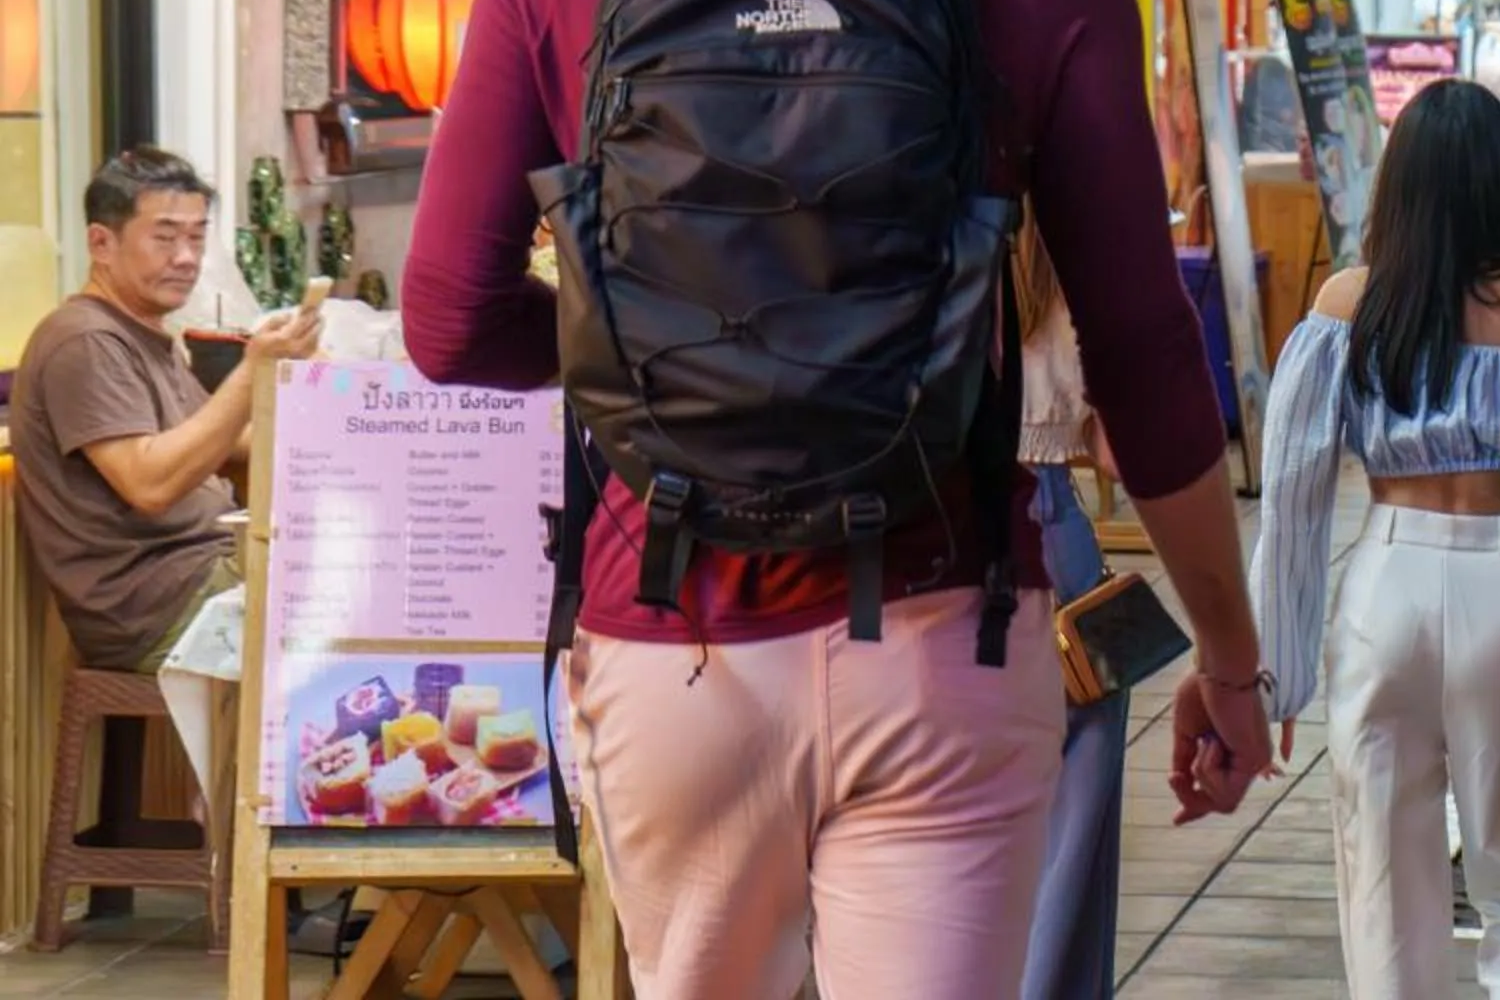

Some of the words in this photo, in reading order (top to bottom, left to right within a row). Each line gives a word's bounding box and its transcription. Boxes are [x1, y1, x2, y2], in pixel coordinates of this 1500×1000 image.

[735, 10, 806, 29] NORTH
[363, 381, 452, 411] ปังลาวา
[346, 416, 429, 435] Steamed
[436, 416, 481, 434] Lava
[488, 416, 525, 434] Bun
